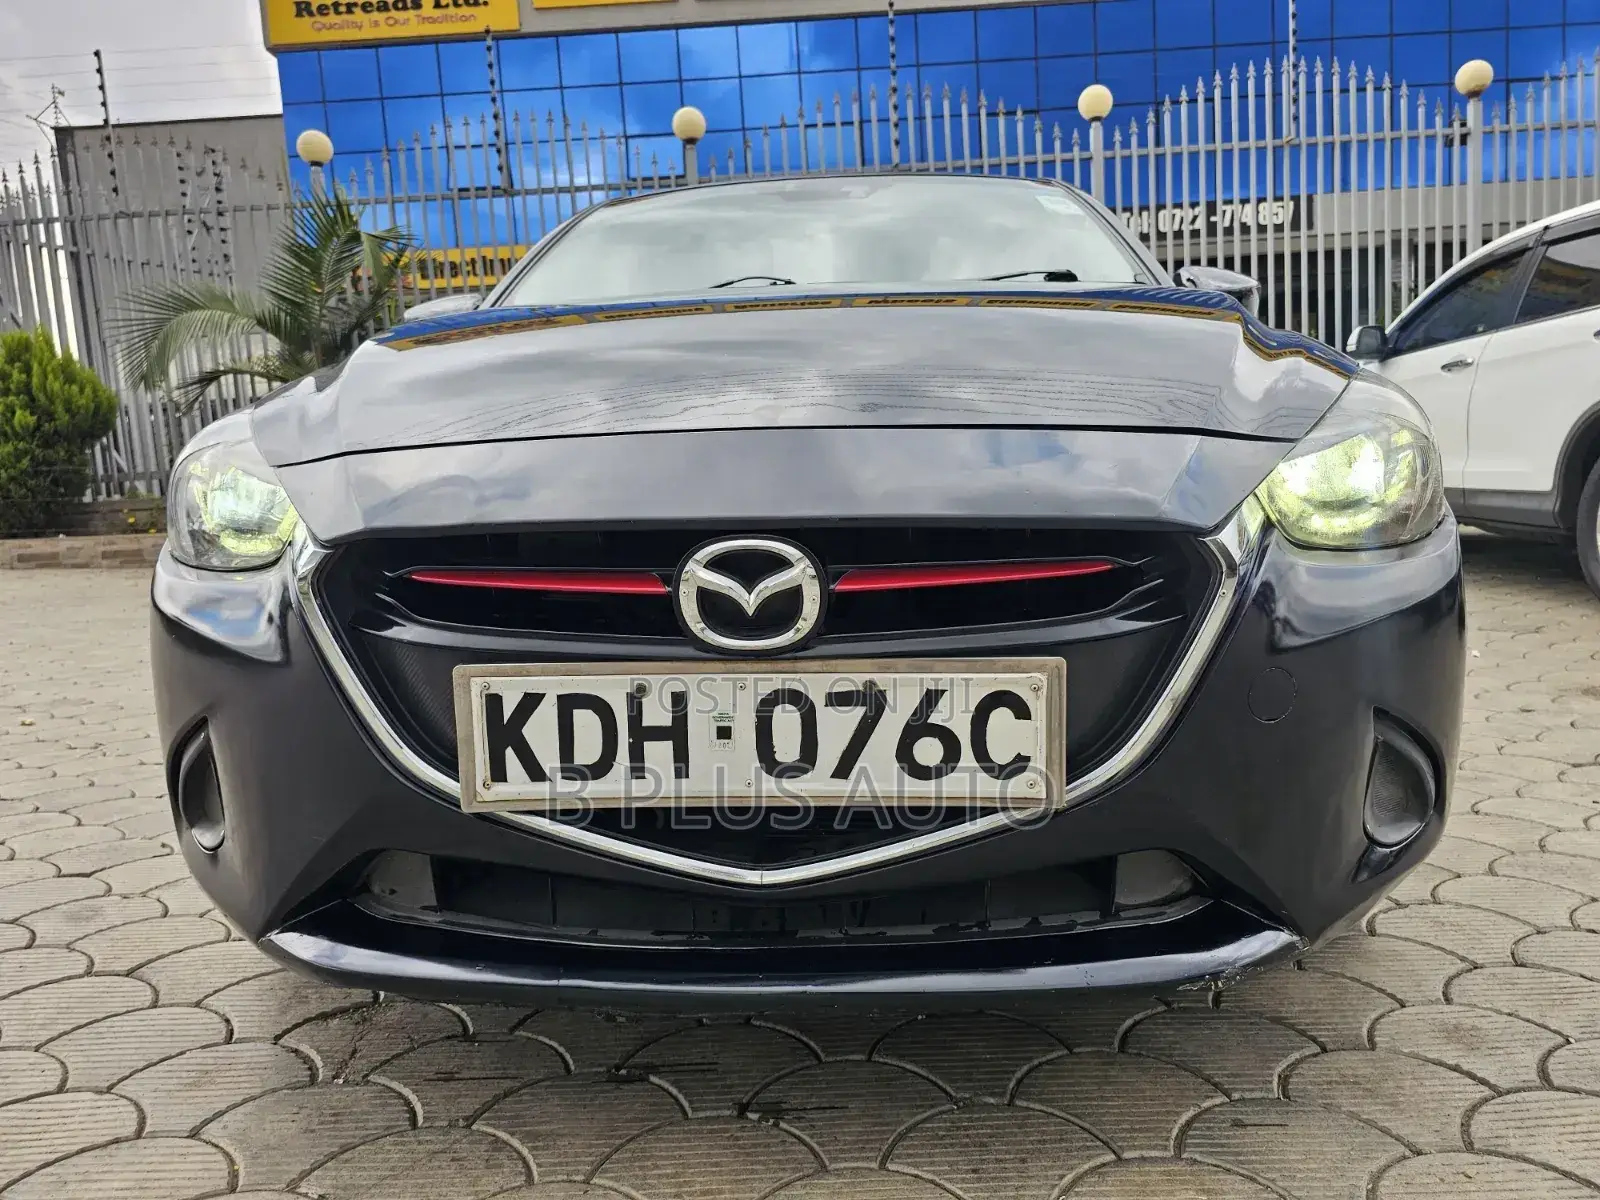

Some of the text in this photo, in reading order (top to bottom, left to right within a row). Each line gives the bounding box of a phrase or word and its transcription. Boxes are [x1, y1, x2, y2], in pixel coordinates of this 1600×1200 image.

[293, 0, 423, 18] Retreads
[311, 19, 363, 34] Quality
[384, 16, 410, 27] Our
[414, 12, 477, 25] Tradition
[484, 688, 1033, 784] KDH 076C
